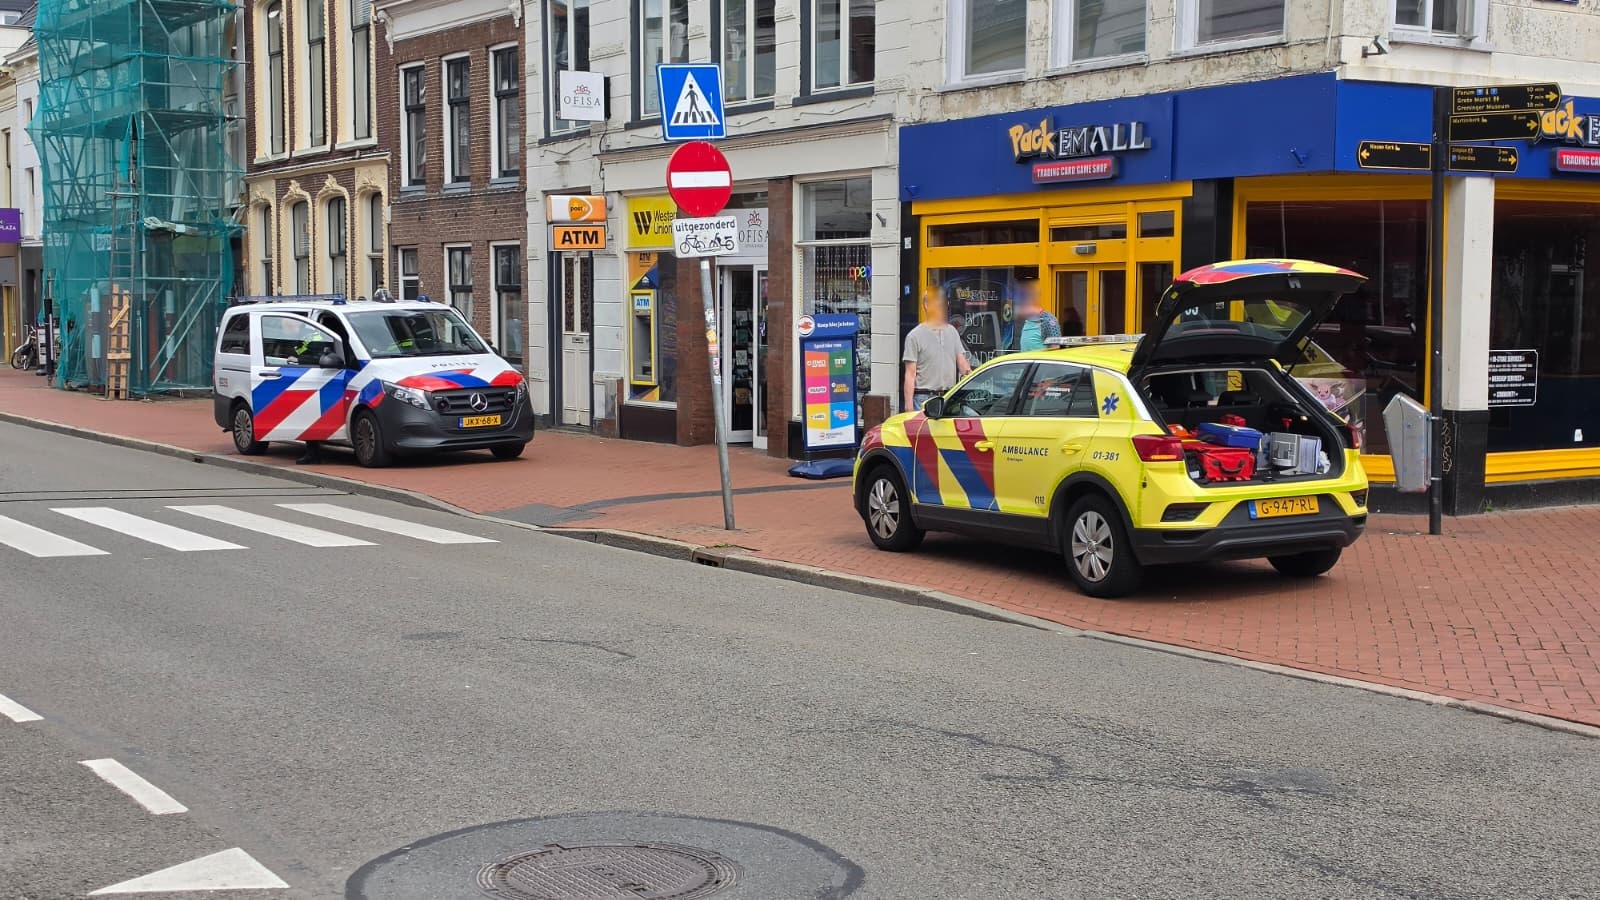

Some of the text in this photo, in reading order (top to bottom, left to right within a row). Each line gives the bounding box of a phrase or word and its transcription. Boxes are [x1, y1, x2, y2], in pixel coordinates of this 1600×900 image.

[564, 96, 601, 106] OFISA
[1538, 101, 1584, 138] ack
[1008, 118, 1146, 158] Pack EMALL
[1562, 155, 1590, 166] TRADING
[1037, 163, 1108, 178] TRADING CARD GAME SHOP
[654, 210, 677, 222] Wester
[654, 222, 672, 234] Union
[676, 220, 736, 234] uitgezonderd
[561, 231, 598, 244] ATM
[965, 312, 986, 328] BUY
[966, 334, 984, 344] SELL
[964, 350, 994, 363] RADE
[466, 417, 498, 426] JKX-68-X
[1002, 446, 1049, 456] AMBULANCE
[1093, 451, 1120, 461] 01-381
[1262, 498, 1314, 514] G-947-RL
